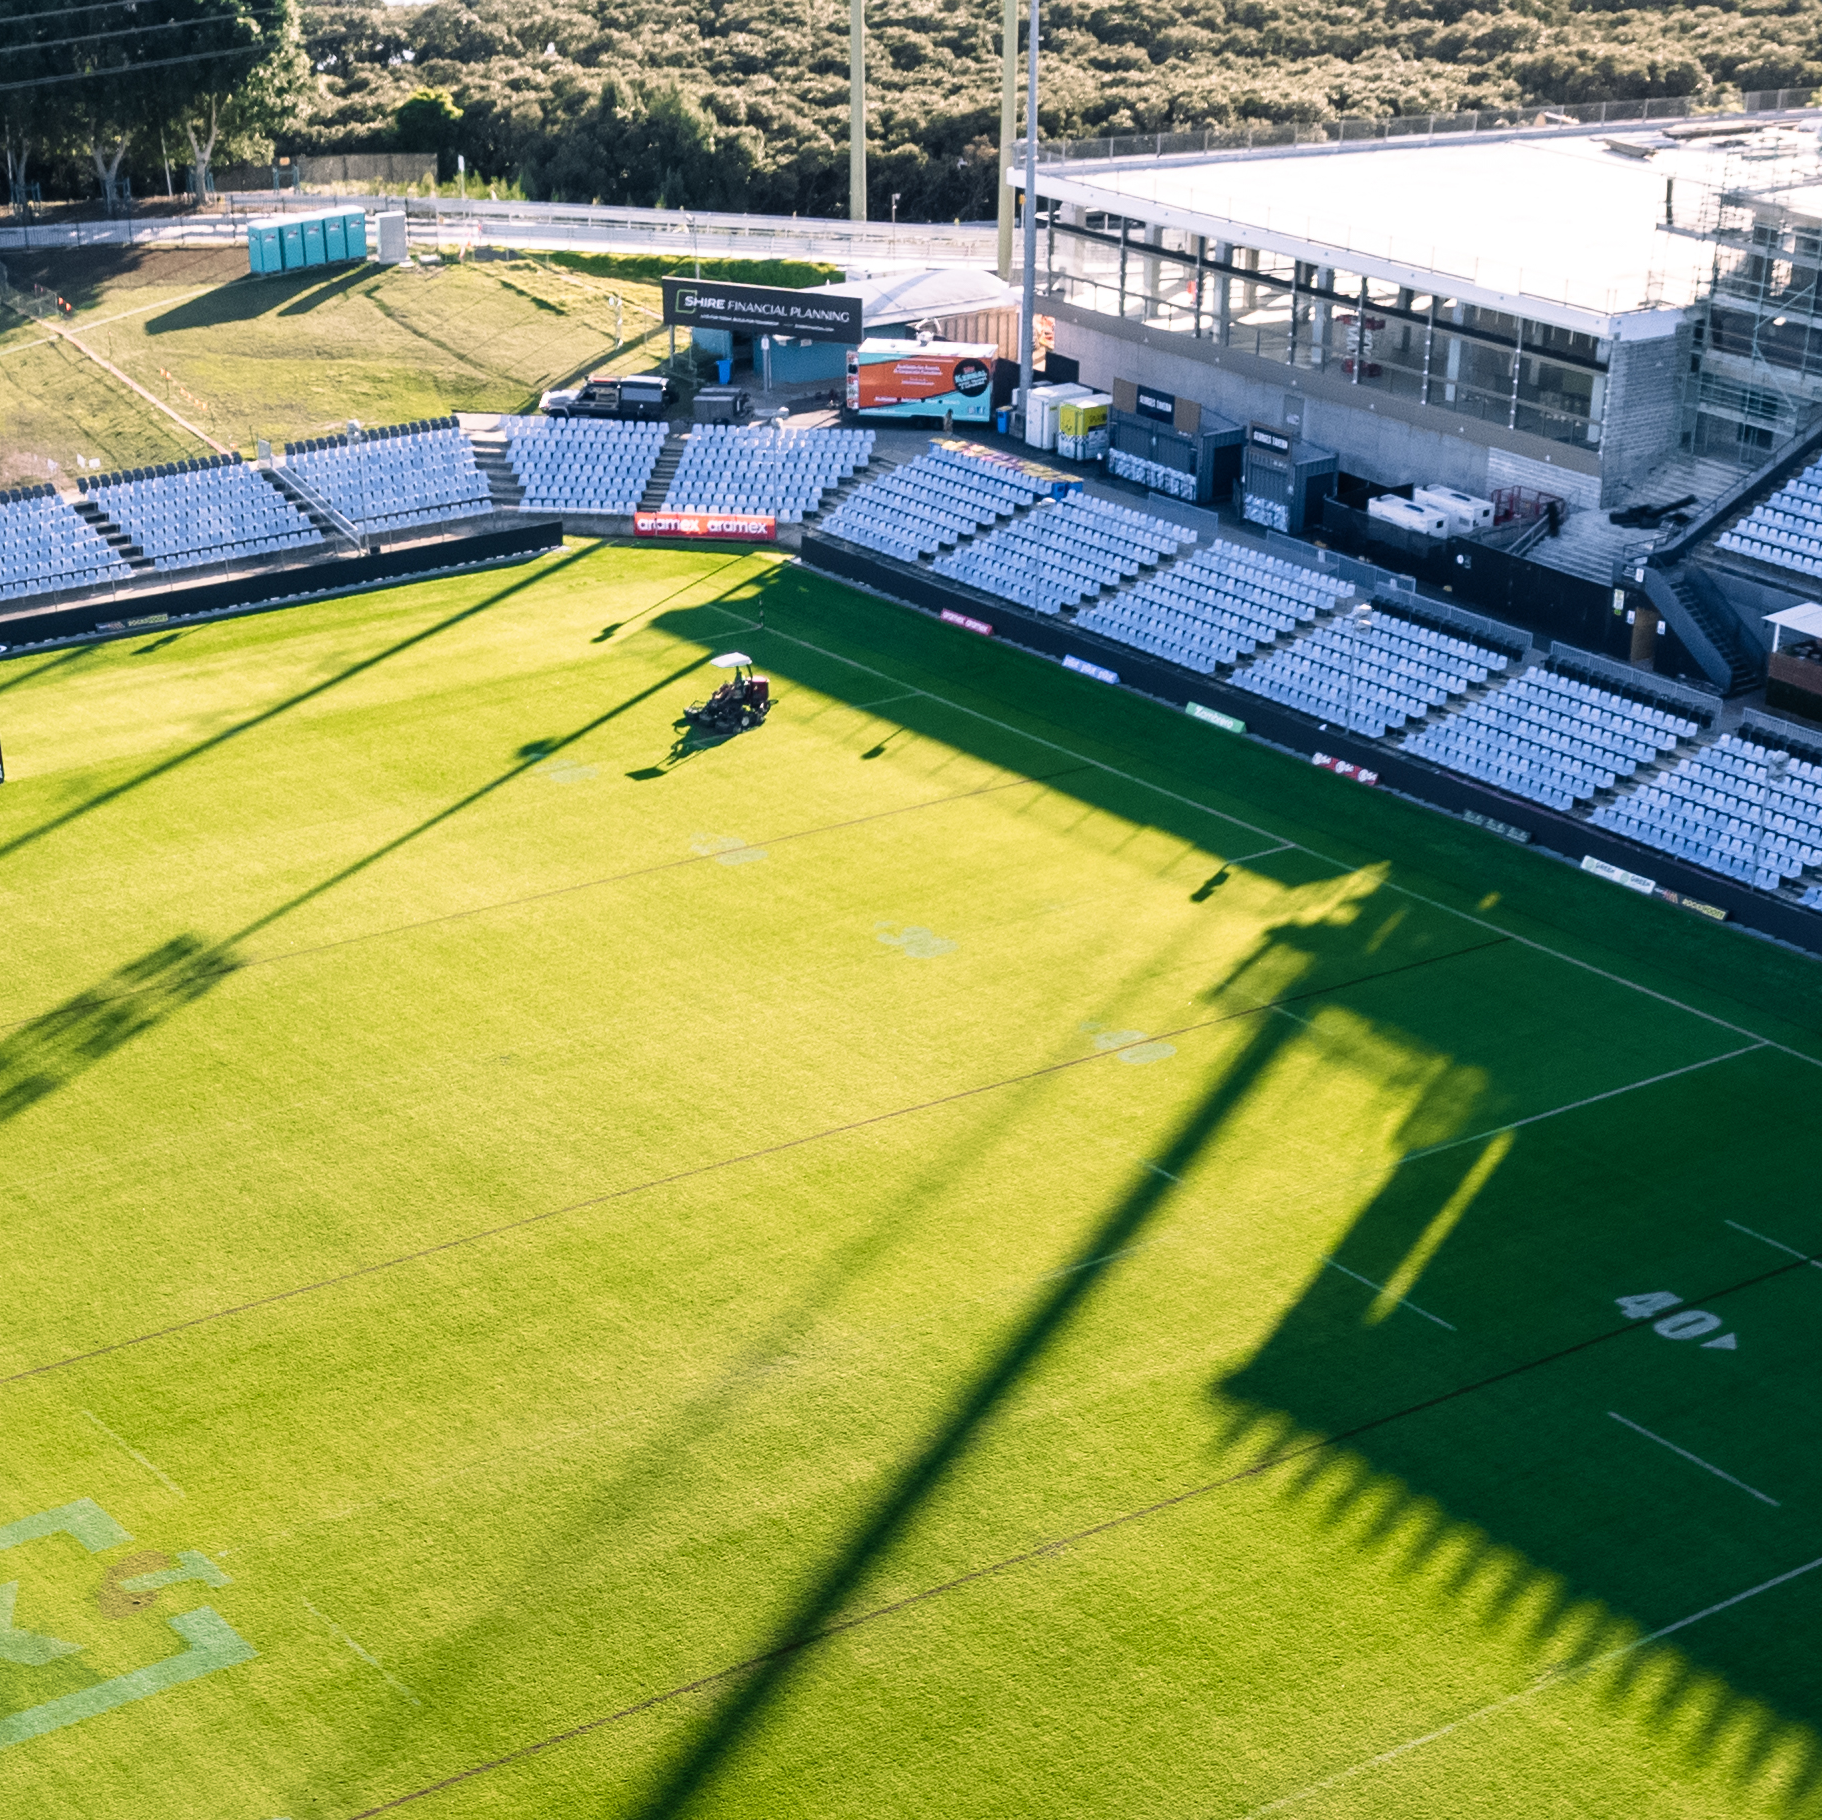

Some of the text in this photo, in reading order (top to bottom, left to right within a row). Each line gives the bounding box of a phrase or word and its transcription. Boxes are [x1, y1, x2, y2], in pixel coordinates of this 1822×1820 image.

[684, 295, 725, 310] SHIRE
[727, 300, 787, 317] FINANCIAL
[790, 305, 850, 323] PLANNING
[637, 517, 767, 534] aramex aramex
[1614, 1289, 1723, 1340] 40
